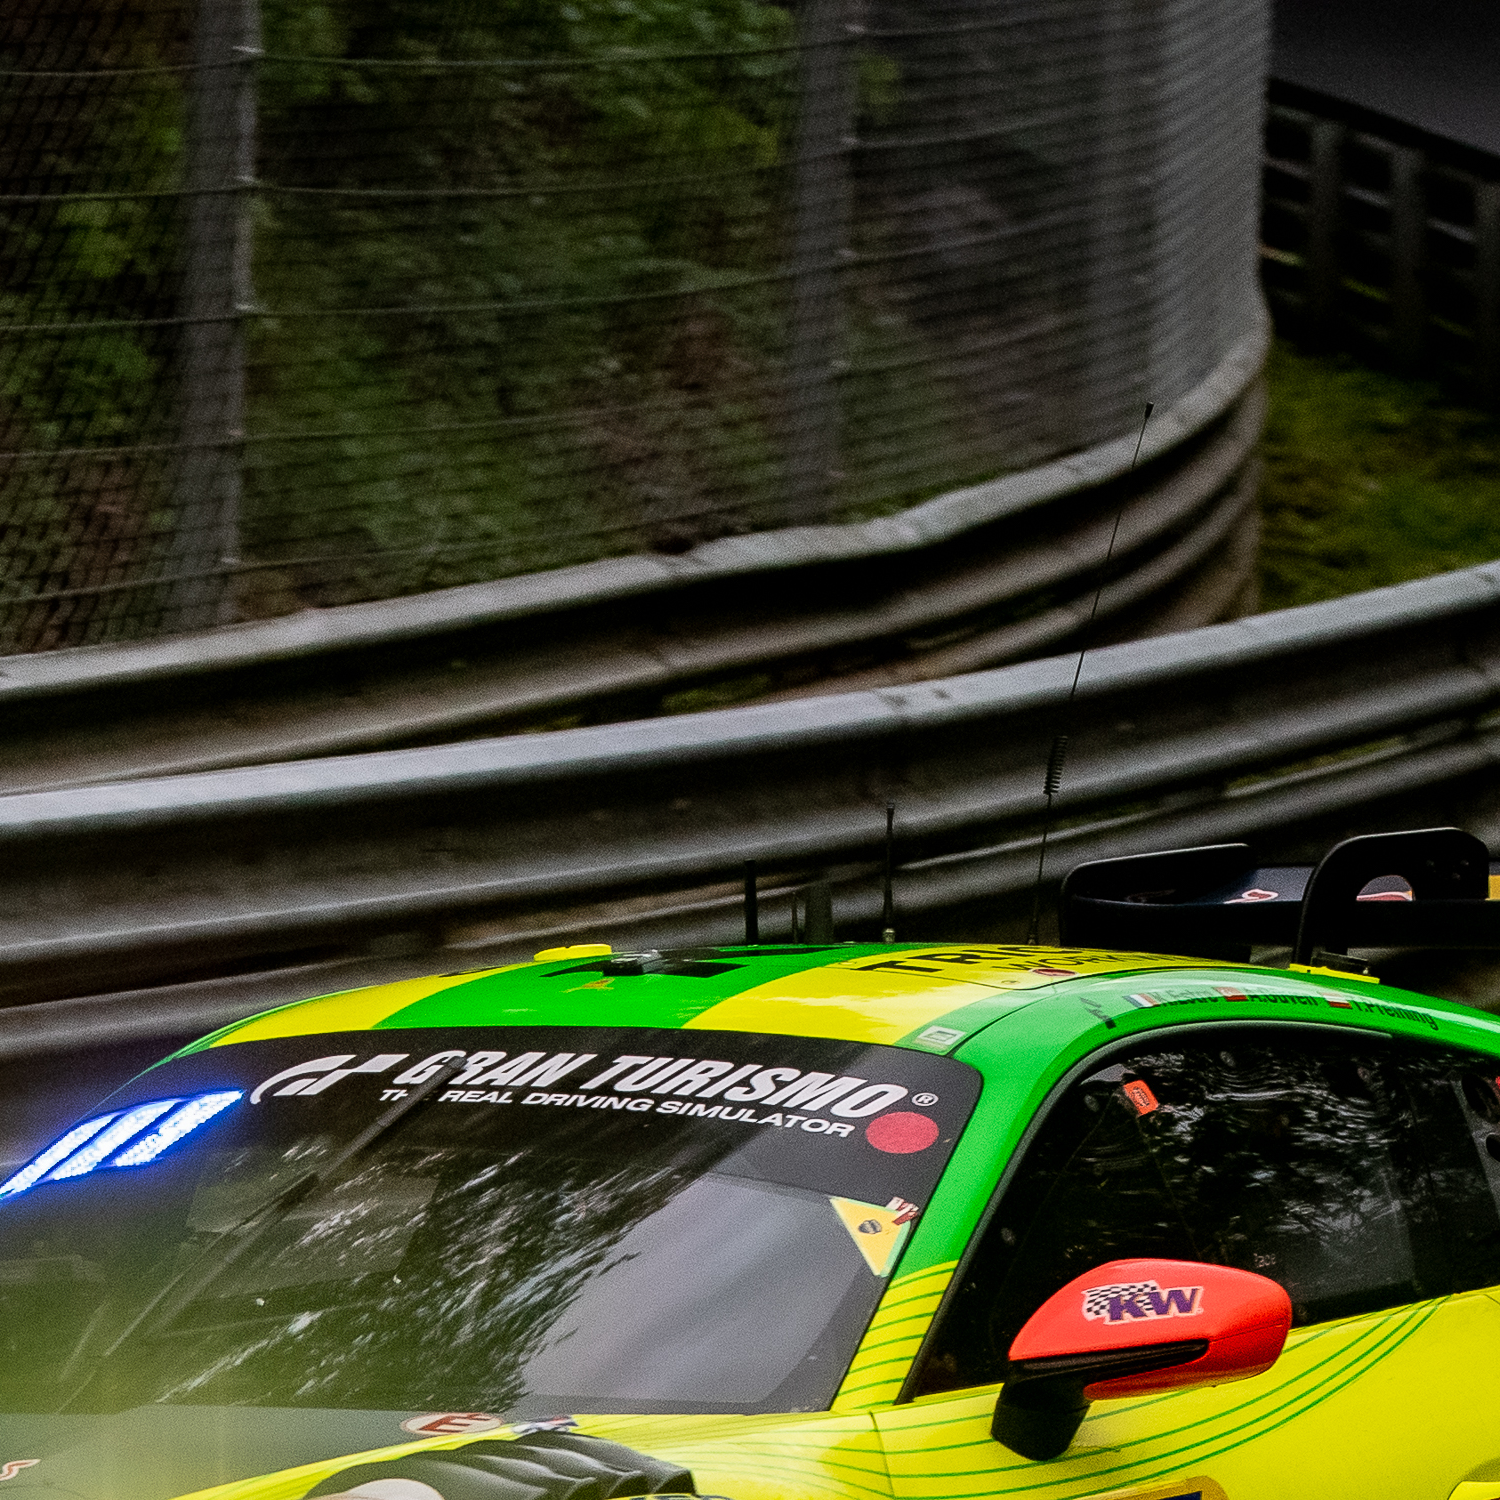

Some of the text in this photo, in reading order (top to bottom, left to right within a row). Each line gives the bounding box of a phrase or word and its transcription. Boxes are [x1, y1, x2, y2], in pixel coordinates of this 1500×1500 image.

[393, 1050, 597, 1089] GRAN
[579, 1055, 908, 1118] TURISMO
[438, 1090, 513, 1104] REAL
[521, 1093, 655, 1112] DRIVING
[656, 1100, 856, 1138] SIMULATOR
[1107, 1288, 1201, 1322] KW
